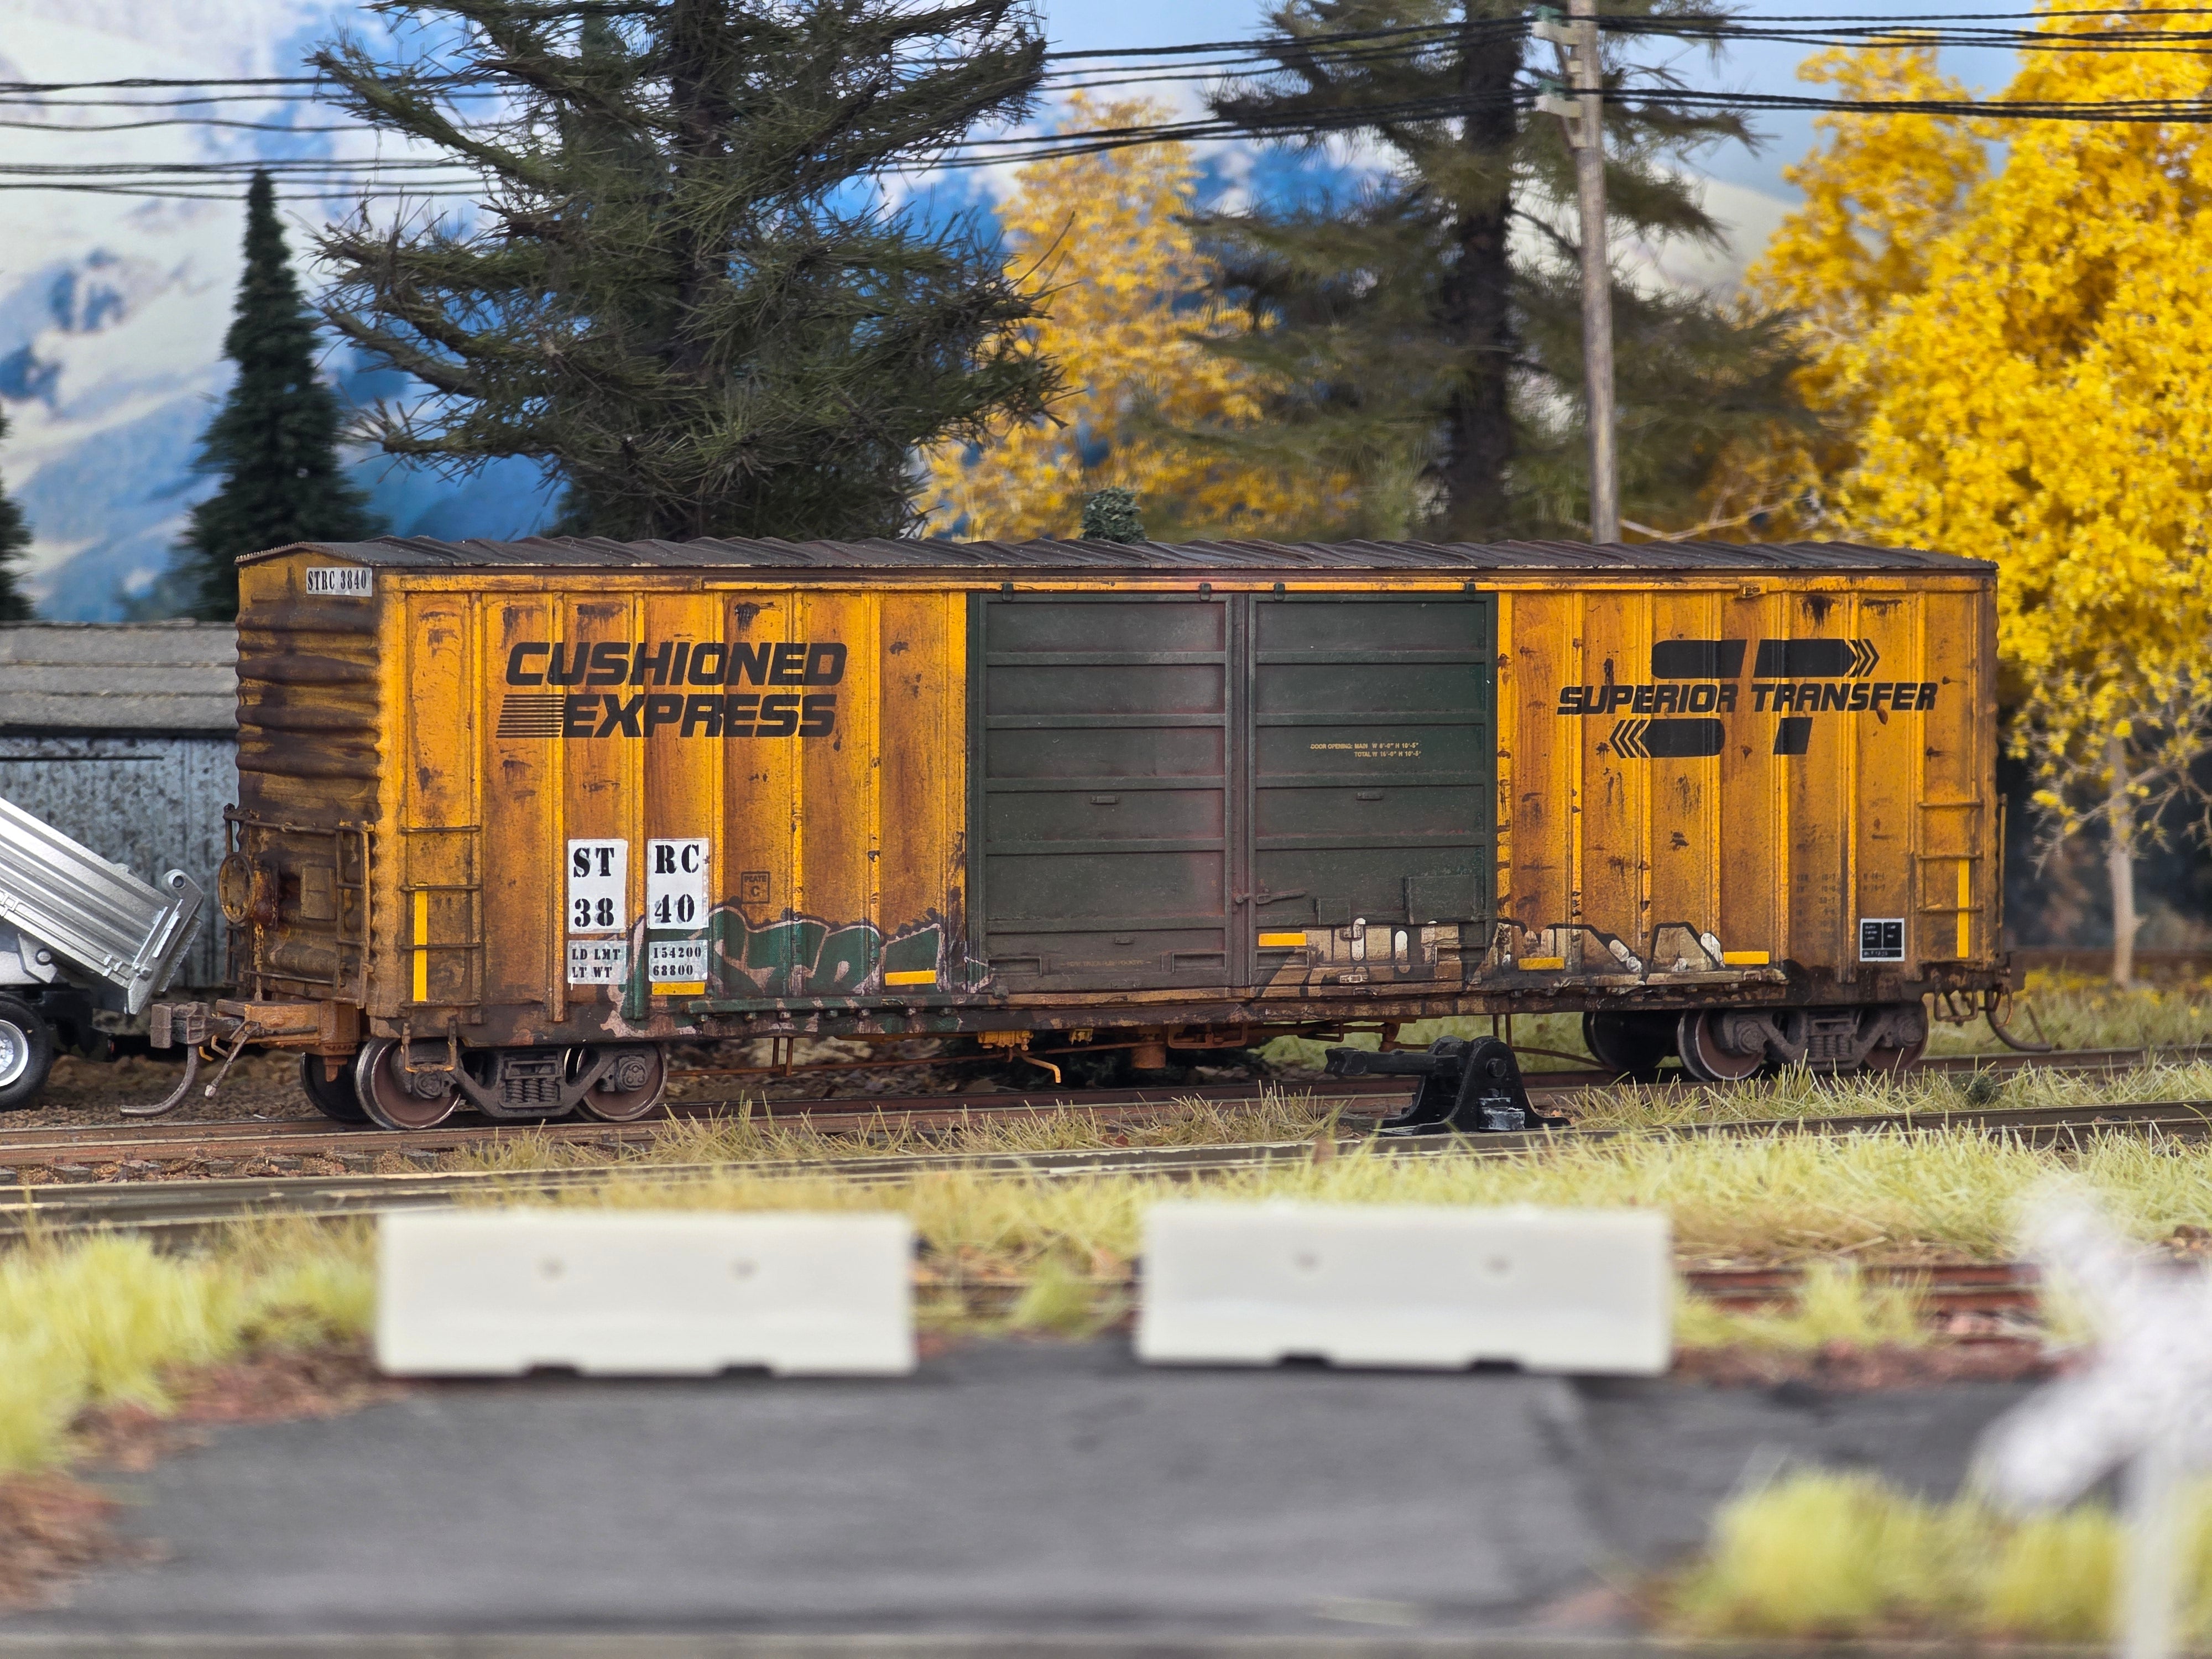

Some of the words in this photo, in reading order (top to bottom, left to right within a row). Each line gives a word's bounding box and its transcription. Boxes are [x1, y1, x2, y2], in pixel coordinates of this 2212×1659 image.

[308, 571, 335, 591] STRC
[341, 570, 367, 589] 3840
[505, 641, 847, 686] CUSHIONED
[1557, 684, 1737, 715] SUPERIOR
[1750, 682, 1938, 712] TRANSFER
[561, 694, 837, 738] EXPRESS
[573, 847, 614, 878] ST
[655, 844, 700, 874] RC
[750, 885, 760, 897] C
[574, 898, 615, 927] 38
[654, 894, 695, 924] 40
[572, 948, 588, 961] LD
[594, 948, 620, 961] LMT
[653, 947, 702, 959] 154200
[571, 967, 587, 978] LT
[594, 966, 613, 978] WT
[653, 965, 693, 977] 68800
